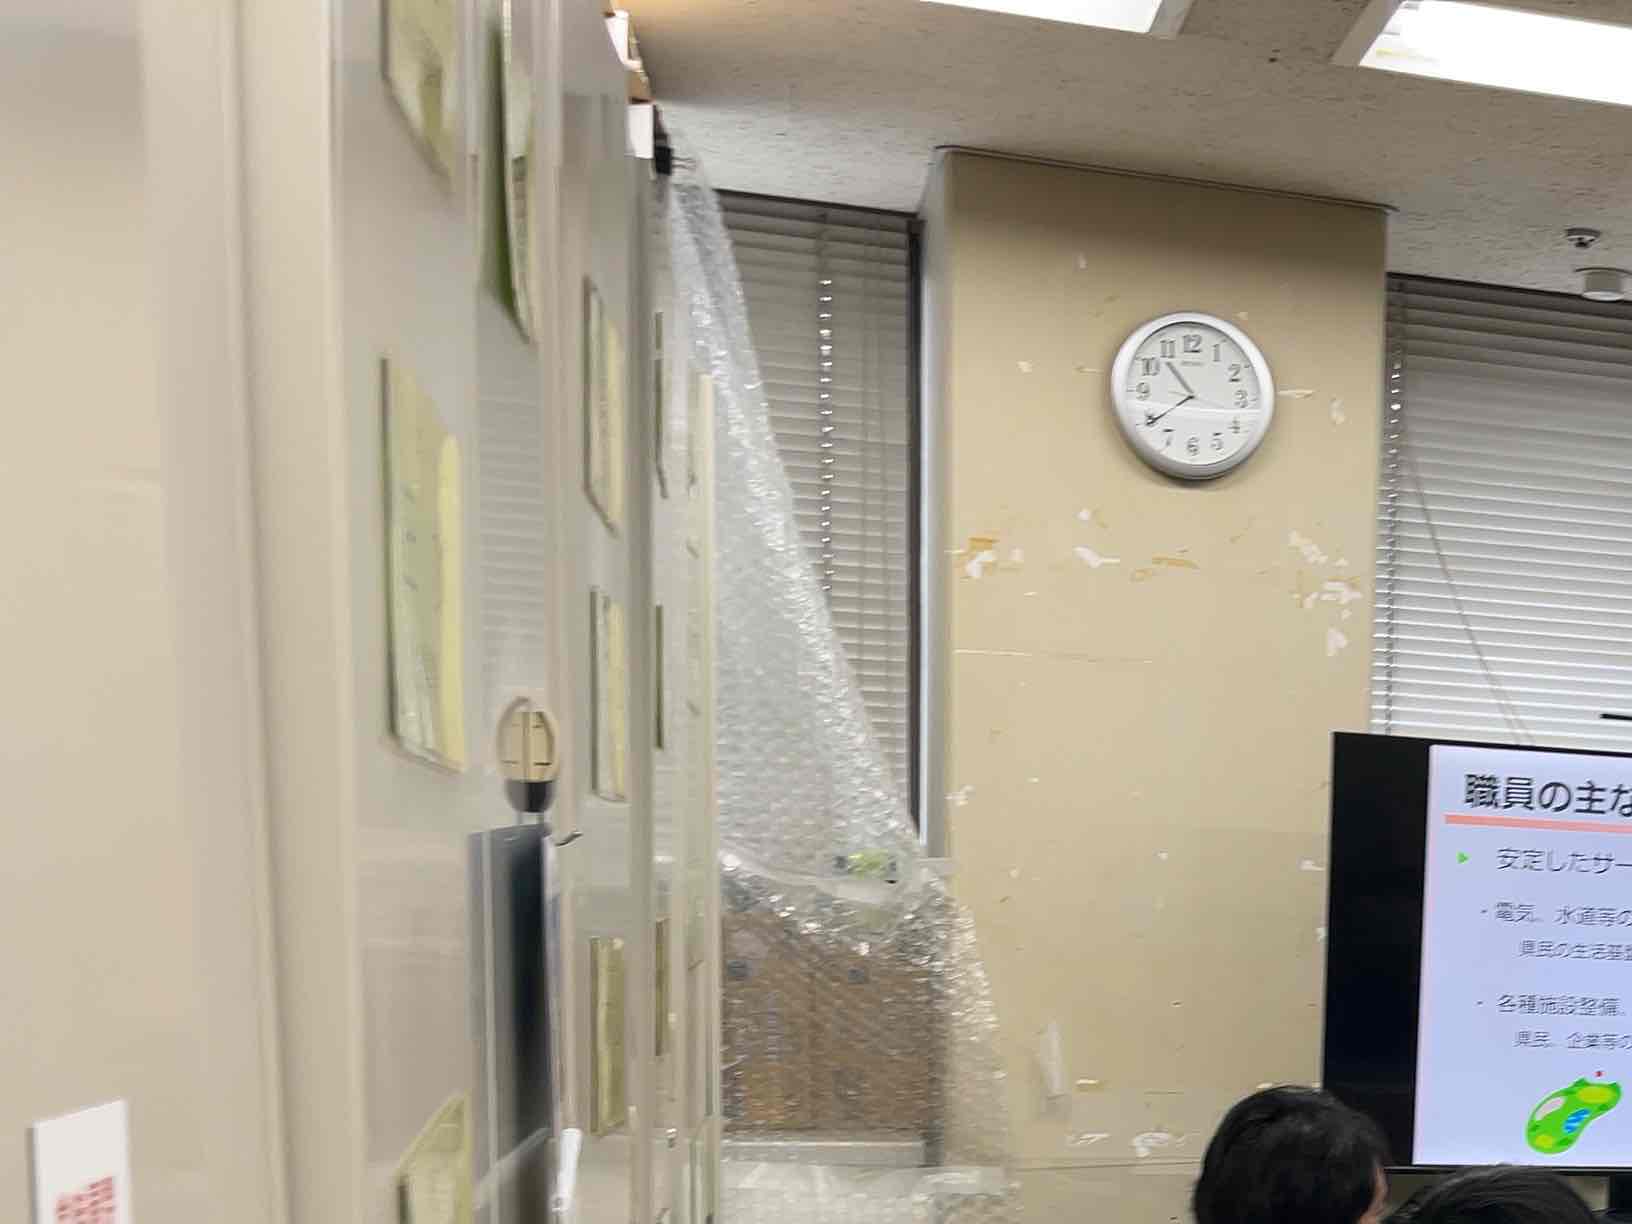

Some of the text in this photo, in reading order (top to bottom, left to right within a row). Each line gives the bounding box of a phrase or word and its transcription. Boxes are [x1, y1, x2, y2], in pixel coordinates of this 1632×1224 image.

[1160, 339, 1176, 359] 11
[1182, 334, 1203, 353] 12
[1213, 343, 1222, 362] 1
[1141, 357, 1160, 376] 10
[1228, 363, 1242, 382] 2
[1135, 382, 1150, 400] 9
[1234, 390, 1248, 409] 3
[1227, 416, 1241, 434] 4
[1163, 428, 1174, 447] 7
[1186, 437, 1199, 456] 6
[1210, 432, 1223, 450] 5
